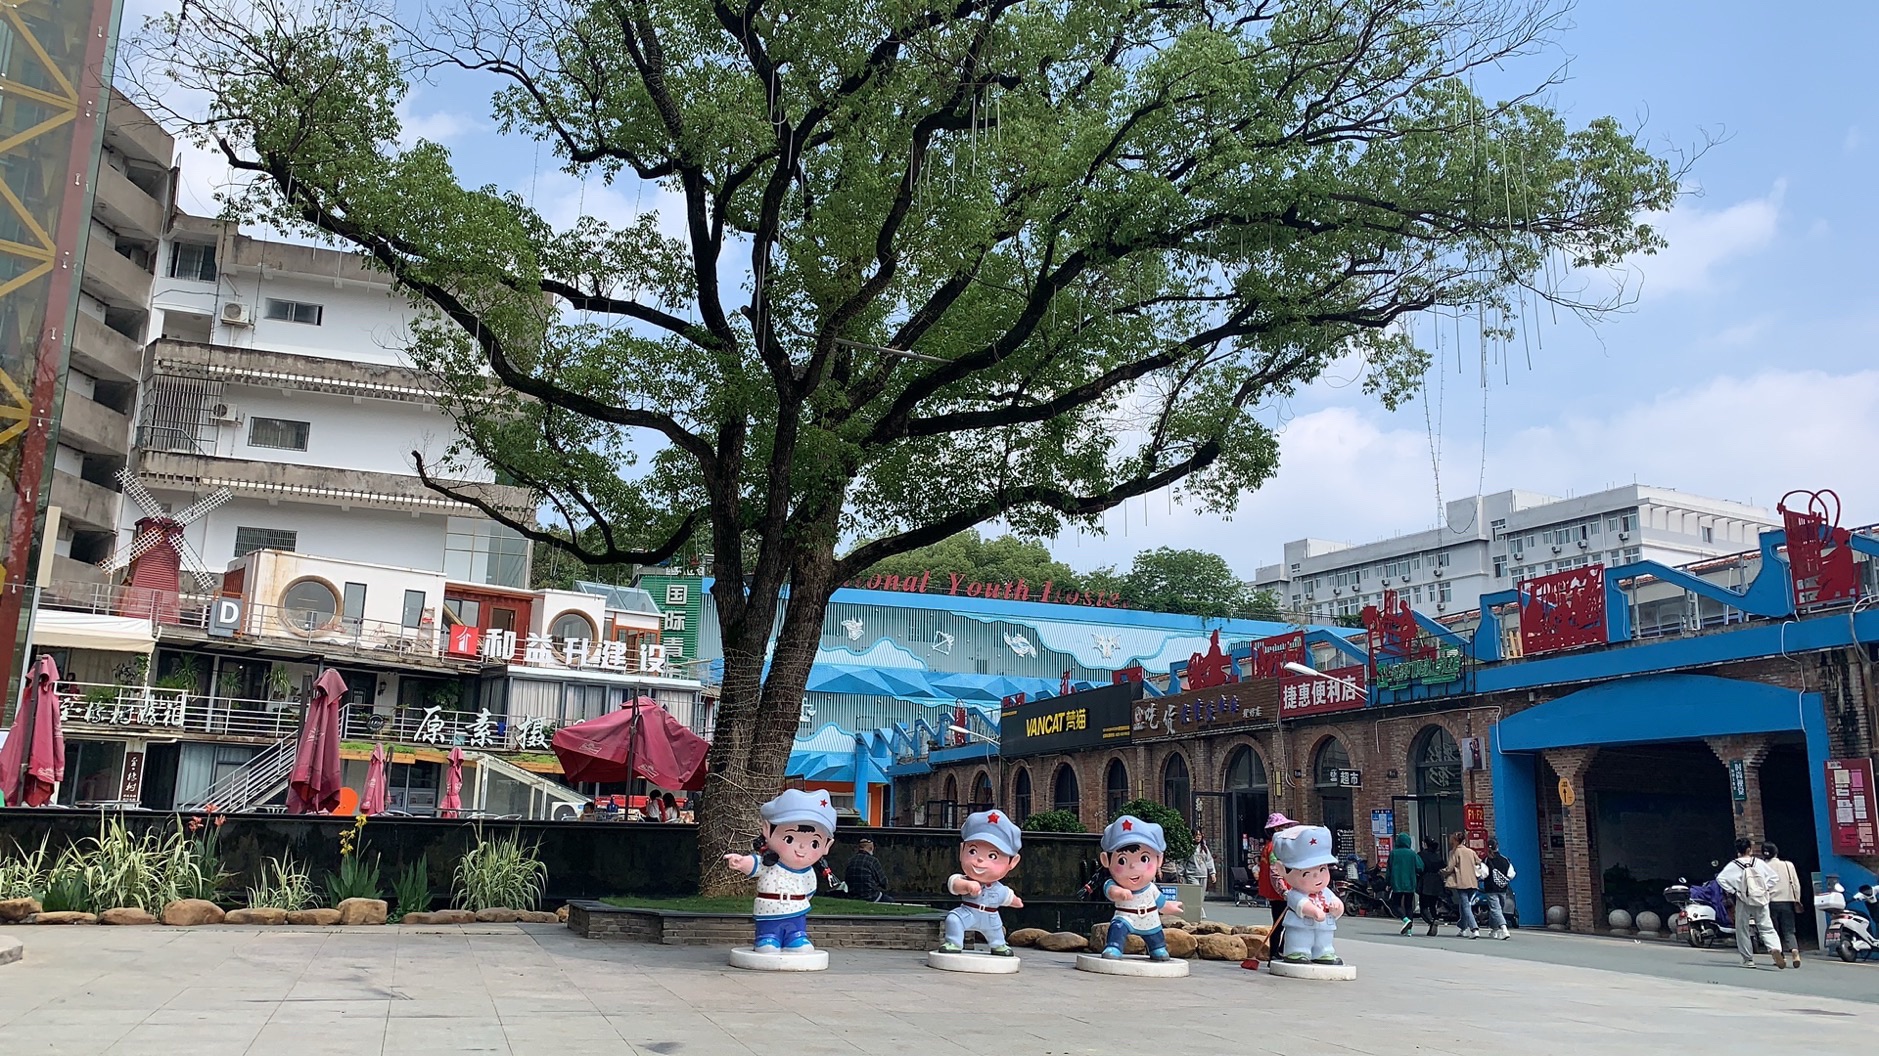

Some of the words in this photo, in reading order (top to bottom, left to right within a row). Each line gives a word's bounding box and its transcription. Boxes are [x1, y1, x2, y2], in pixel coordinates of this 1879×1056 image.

[949, 572, 1029, 600] Youth
[219, 603, 239, 624] D
[1283, 675, 1356, 710] 捷惠便利店
[1026, 711, 1066, 737] VANCAT
[1340, 771, 1359, 785] 超市
